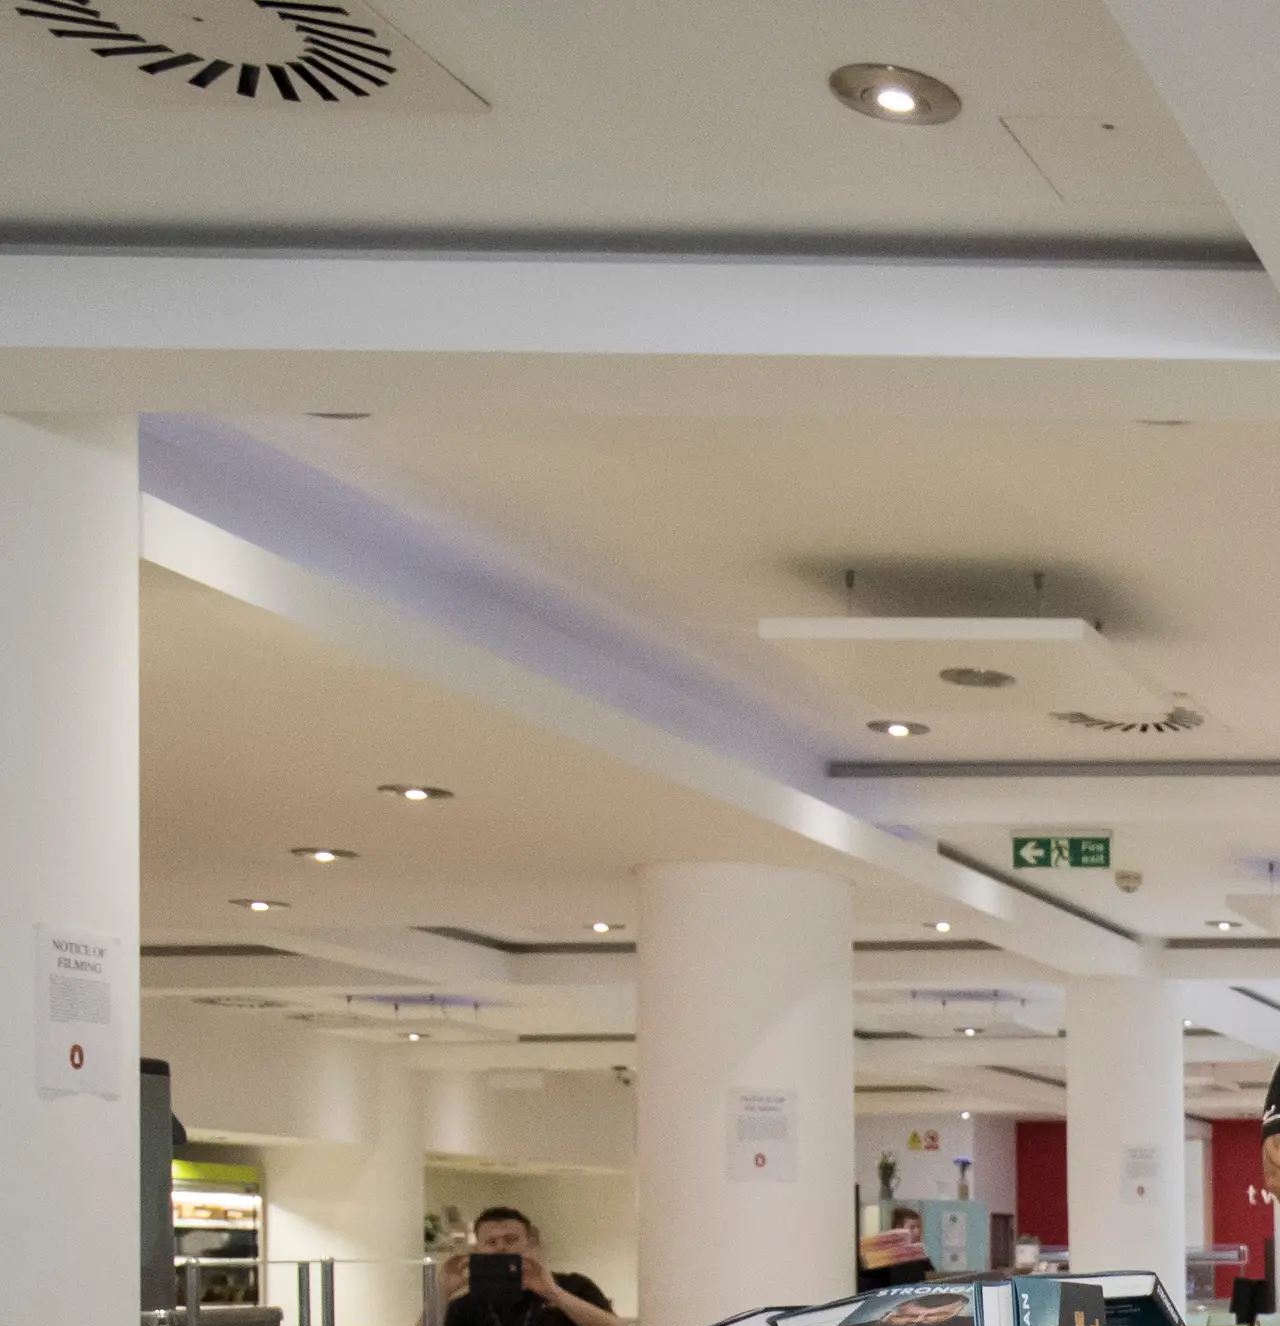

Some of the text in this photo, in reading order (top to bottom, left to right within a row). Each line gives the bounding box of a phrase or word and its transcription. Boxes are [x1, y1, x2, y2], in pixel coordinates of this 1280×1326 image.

[1081, 841, 1104, 852] Fire
[52, 938, 107, 958] NOTICE OF
[57, 956, 102, 974] FILMING
